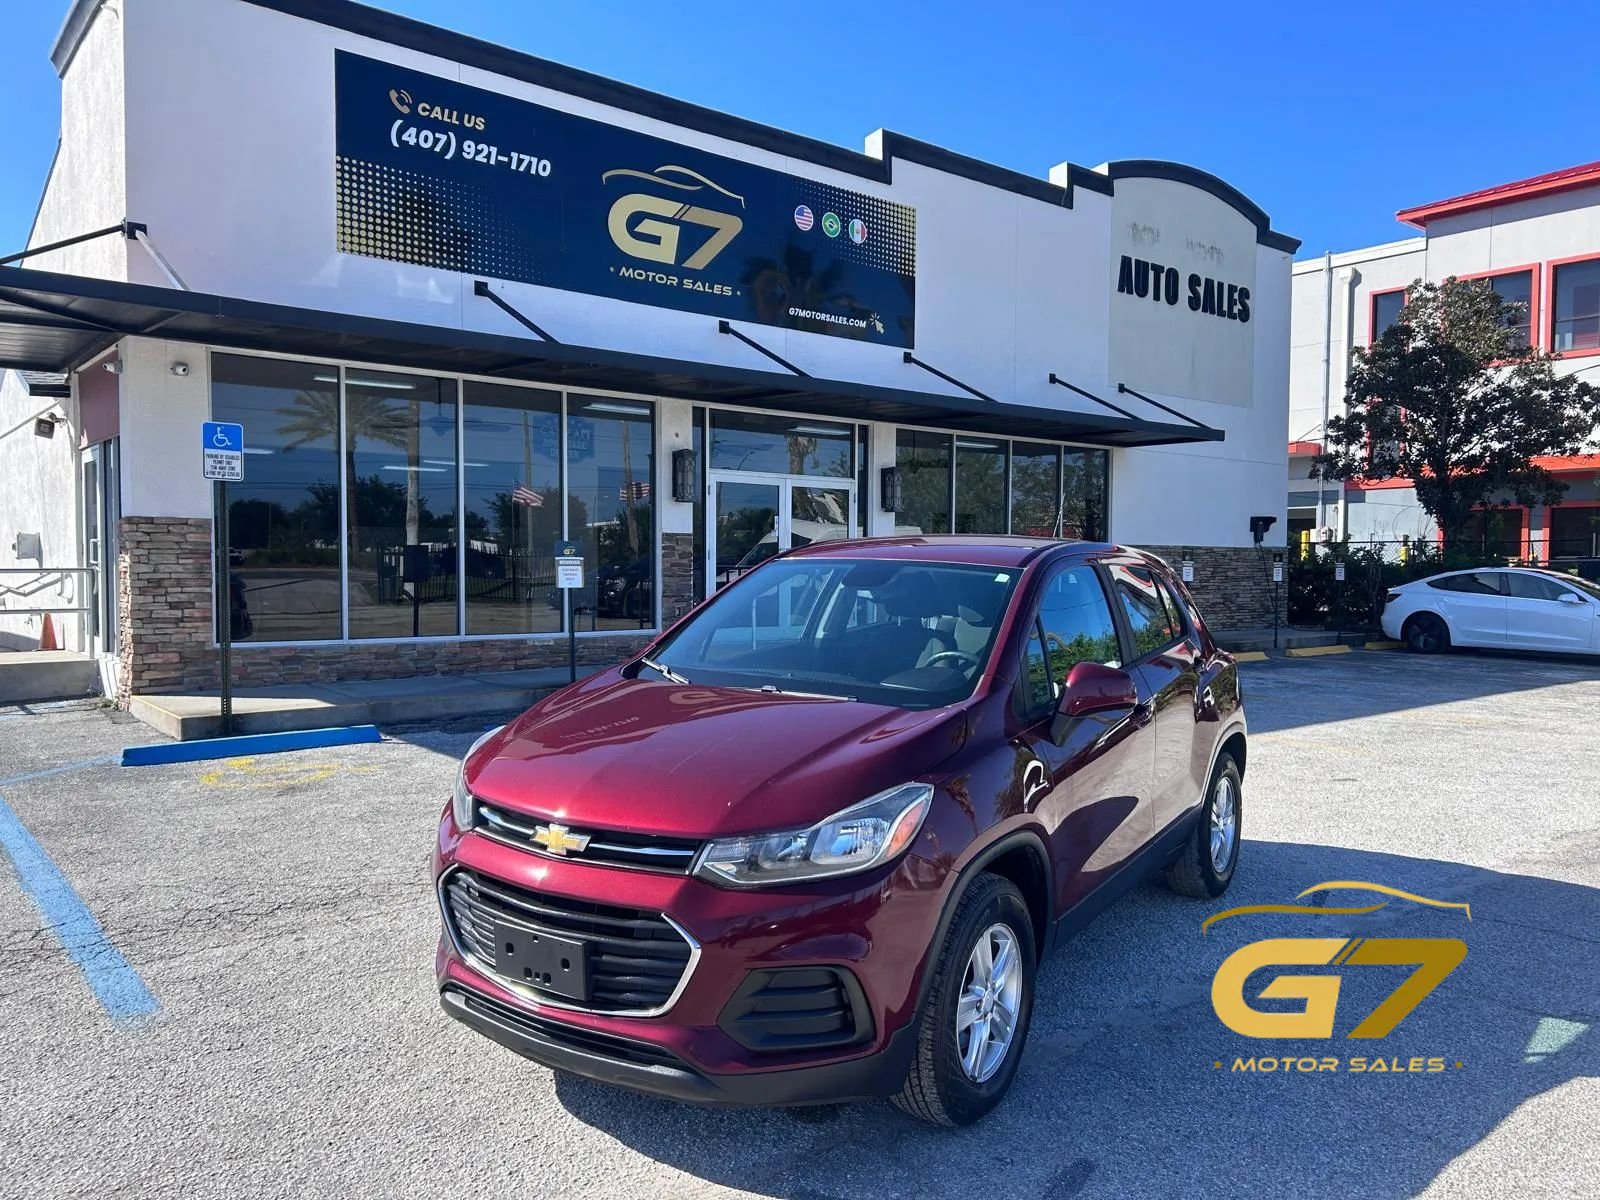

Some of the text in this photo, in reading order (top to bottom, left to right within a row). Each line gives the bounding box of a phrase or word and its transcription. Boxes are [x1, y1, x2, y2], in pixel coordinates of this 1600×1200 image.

[417, 102, 486, 131] CALL US
[390, 119, 551, 177] (407) 921-1710
[607, 193, 743, 270] G7
[619, 266, 733, 296] MOTOR SALES
[1117, 254, 1251, 324] AUTO SALES
[788, 307, 867, 328] G7MOTORSALES.COM
